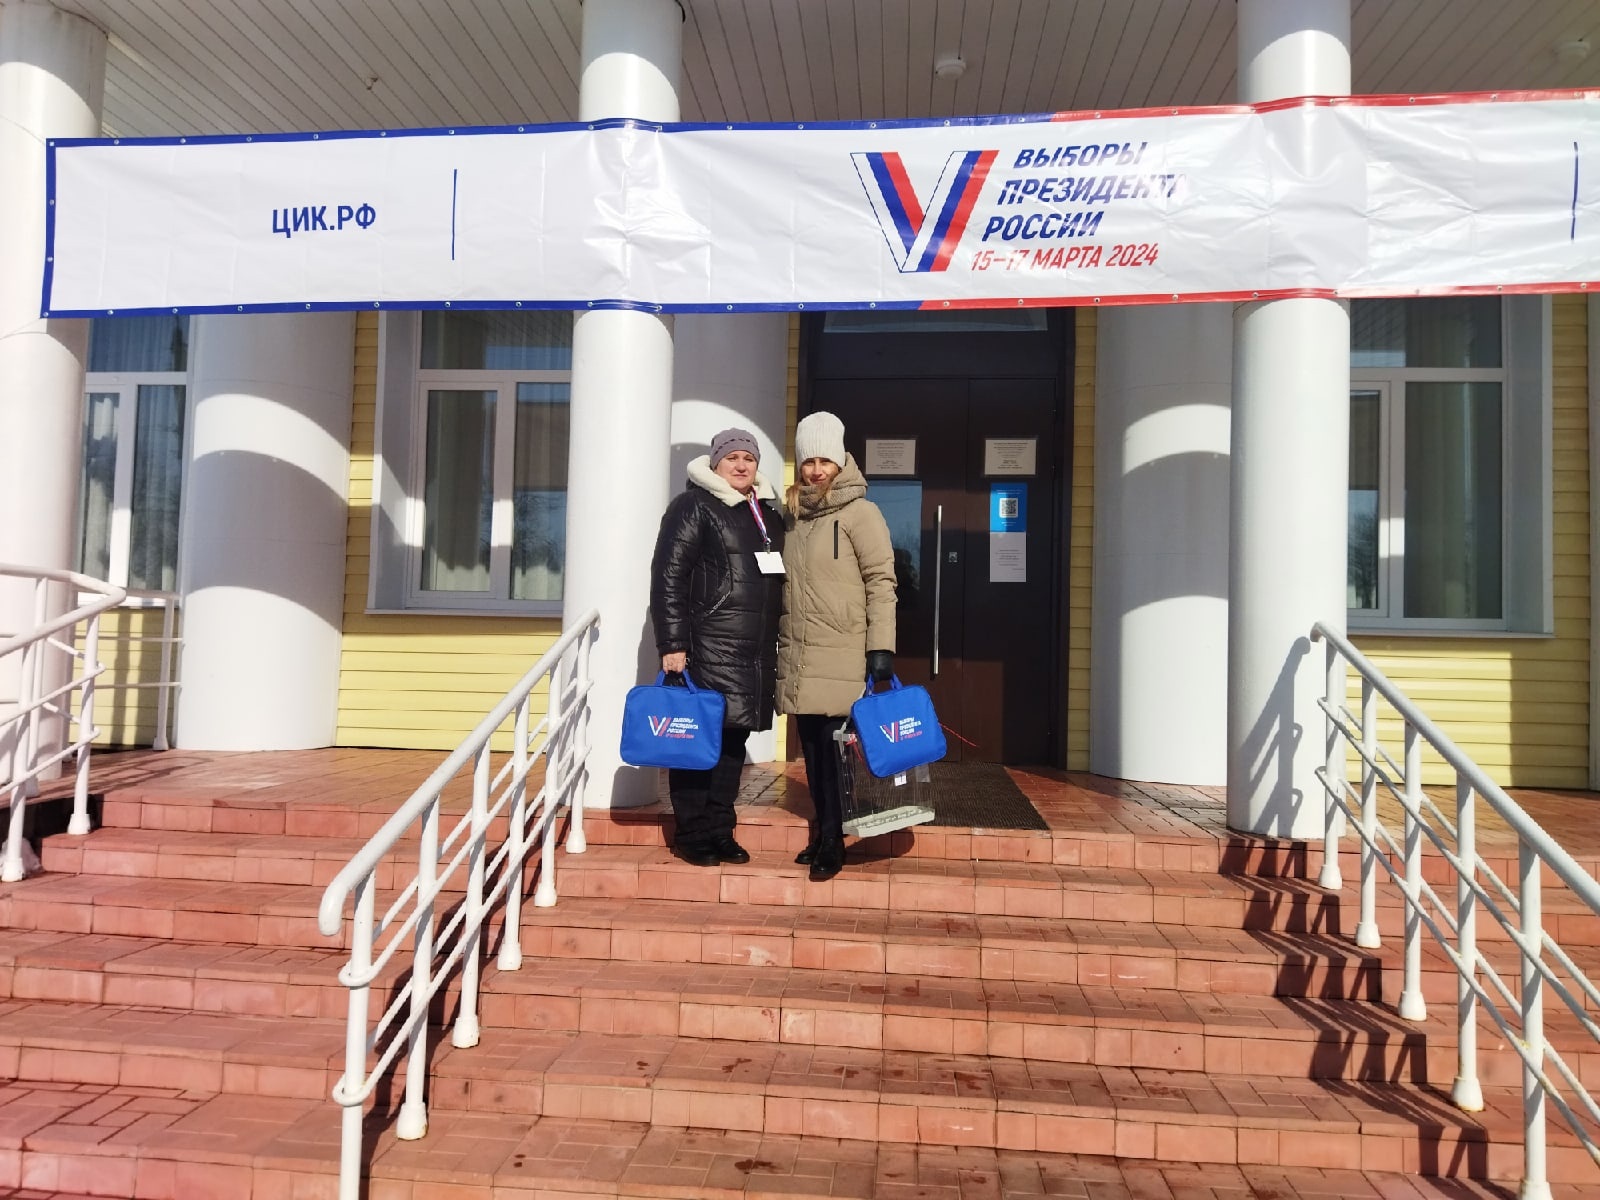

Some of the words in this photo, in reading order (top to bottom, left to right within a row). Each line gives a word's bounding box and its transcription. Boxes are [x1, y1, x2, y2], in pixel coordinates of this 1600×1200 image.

[1013, 141, 1148, 169] ВЫБОРЫ
[272, 203, 376, 238] ЦИК.РФ
[982, 211, 1104, 242] РОССИИ
[1030, 246, 1102, 270] МАРТА
[1105, 242, 1160, 267] 2024
